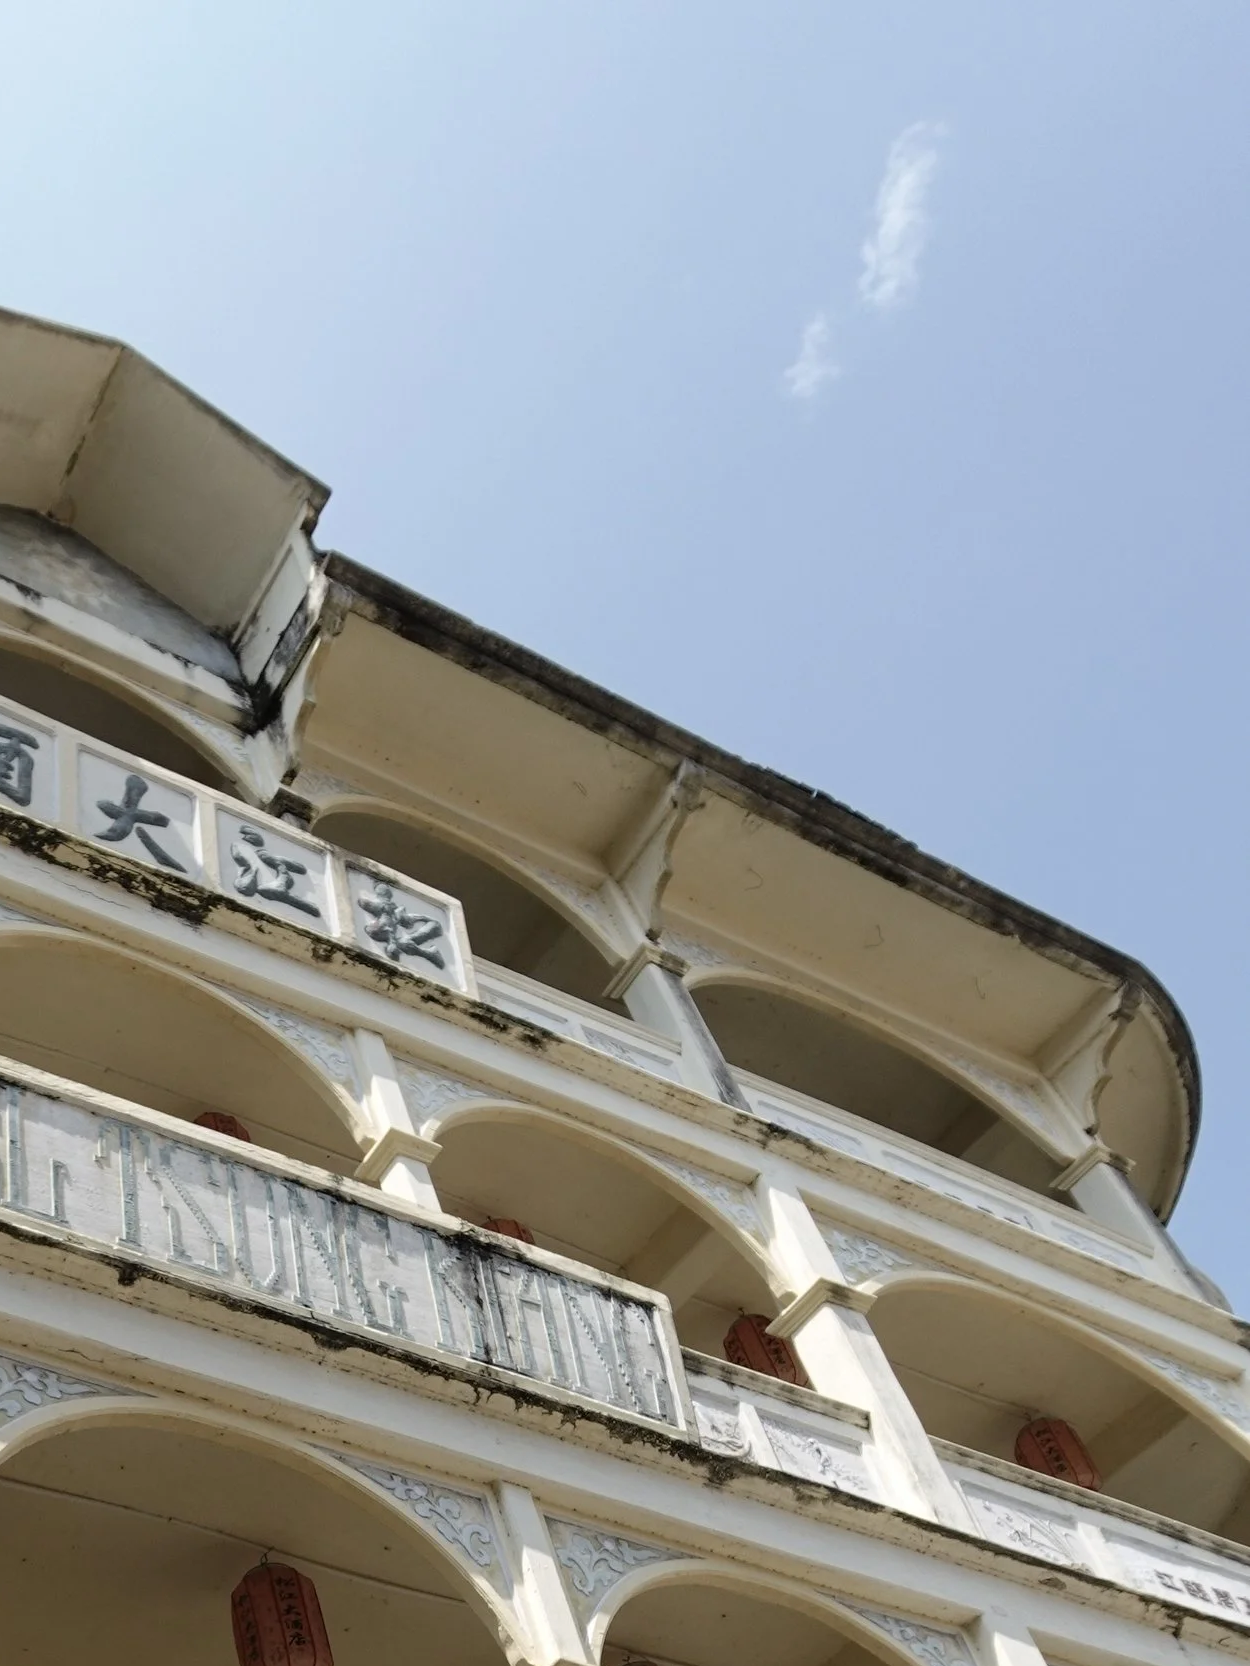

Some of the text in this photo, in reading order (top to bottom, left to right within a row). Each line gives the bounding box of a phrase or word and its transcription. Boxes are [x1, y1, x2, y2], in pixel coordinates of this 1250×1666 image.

[274, 1576, 307, 1648] 松江大酒店
